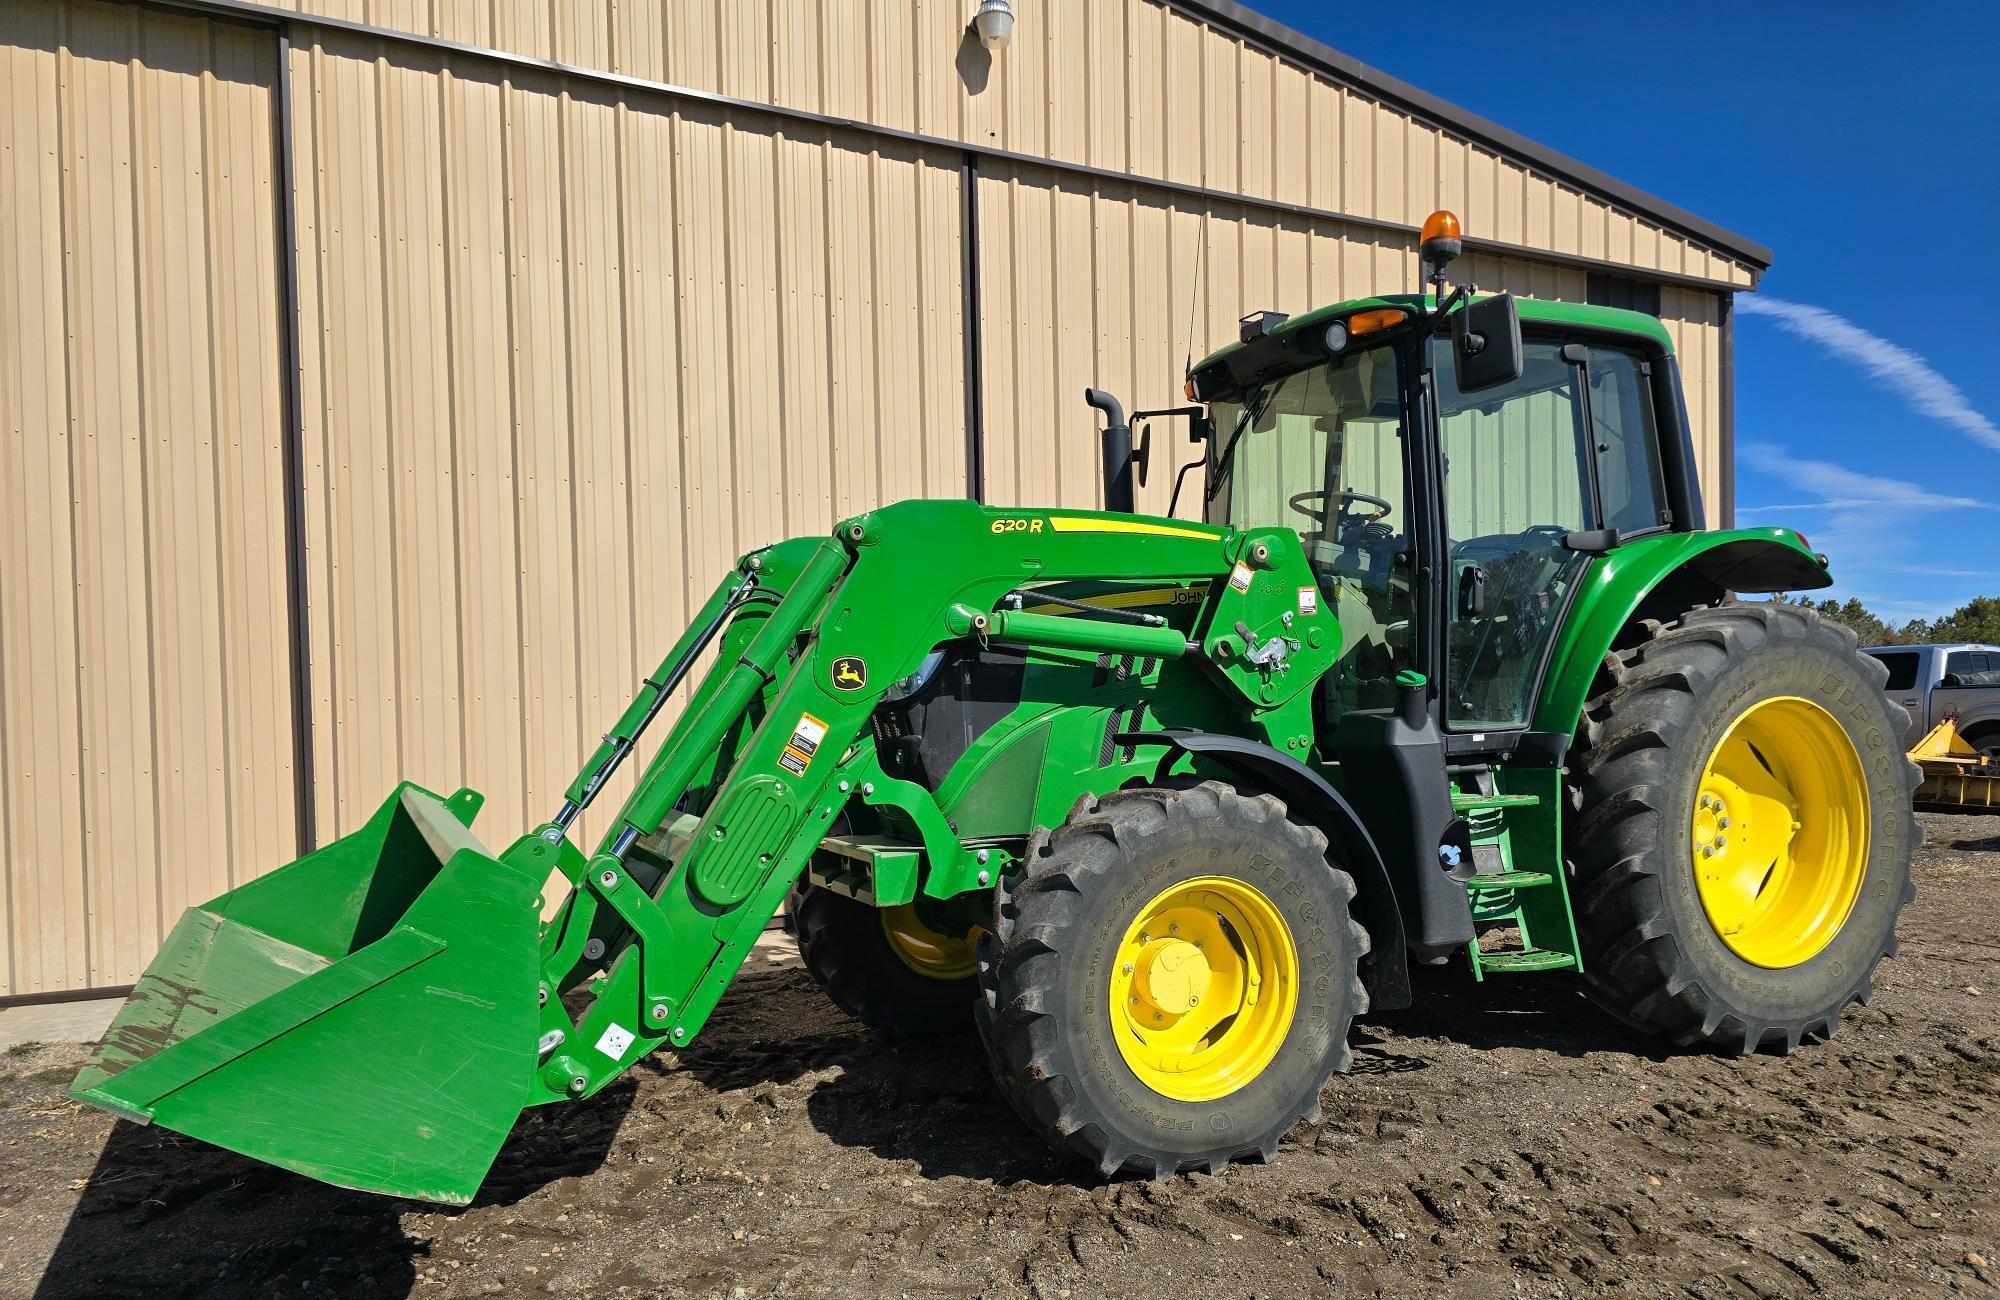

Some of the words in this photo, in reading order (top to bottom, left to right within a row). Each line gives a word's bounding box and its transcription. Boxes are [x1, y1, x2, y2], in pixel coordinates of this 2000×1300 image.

[991, 518, 1028, 534] 620
[1029, 518, 1044, 534] R
[1170, 590, 1207, 604] JOHN
[1086, 1026, 1195, 1131] PERFORMER
